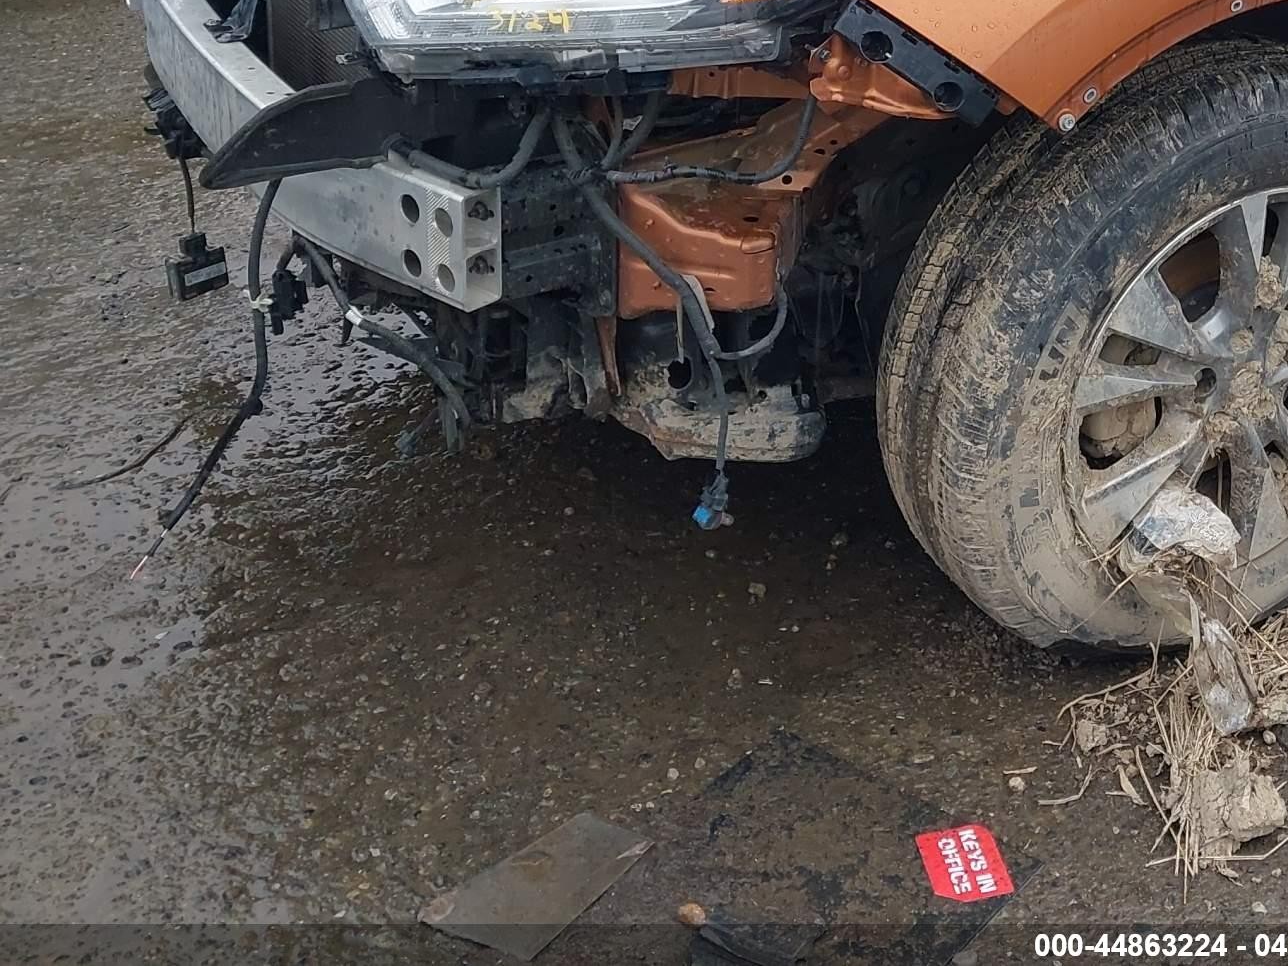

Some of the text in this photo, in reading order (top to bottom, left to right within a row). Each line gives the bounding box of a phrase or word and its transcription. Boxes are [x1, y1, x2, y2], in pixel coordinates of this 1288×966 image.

[937, 837, 973, 895] OFFICE
[958, 829, 997, 893] KEYS IN
